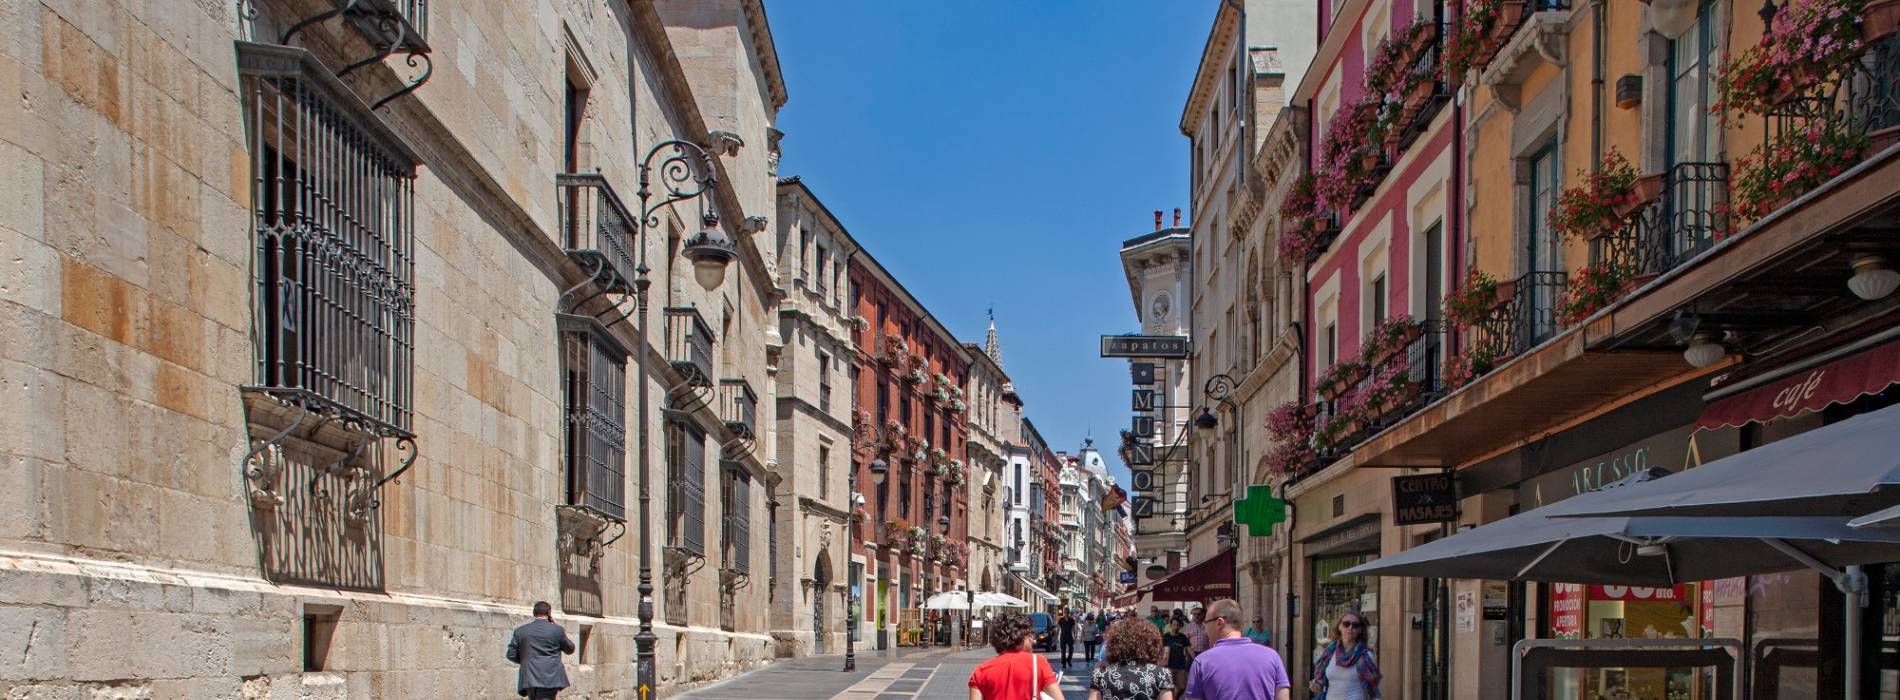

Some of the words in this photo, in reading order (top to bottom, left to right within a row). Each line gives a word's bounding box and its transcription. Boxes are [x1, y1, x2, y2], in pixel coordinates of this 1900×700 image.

[1111, 342, 1178, 351] zapatos
[1773, 370, 1825, 411] café
[1400, 477, 1448, 492] CENTRO
[1400, 504, 1454, 522] MASAJES
[1553, 595, 1580, 611] PROMOCIÓN
[1556, 615, 1577, 627] APERTURA
